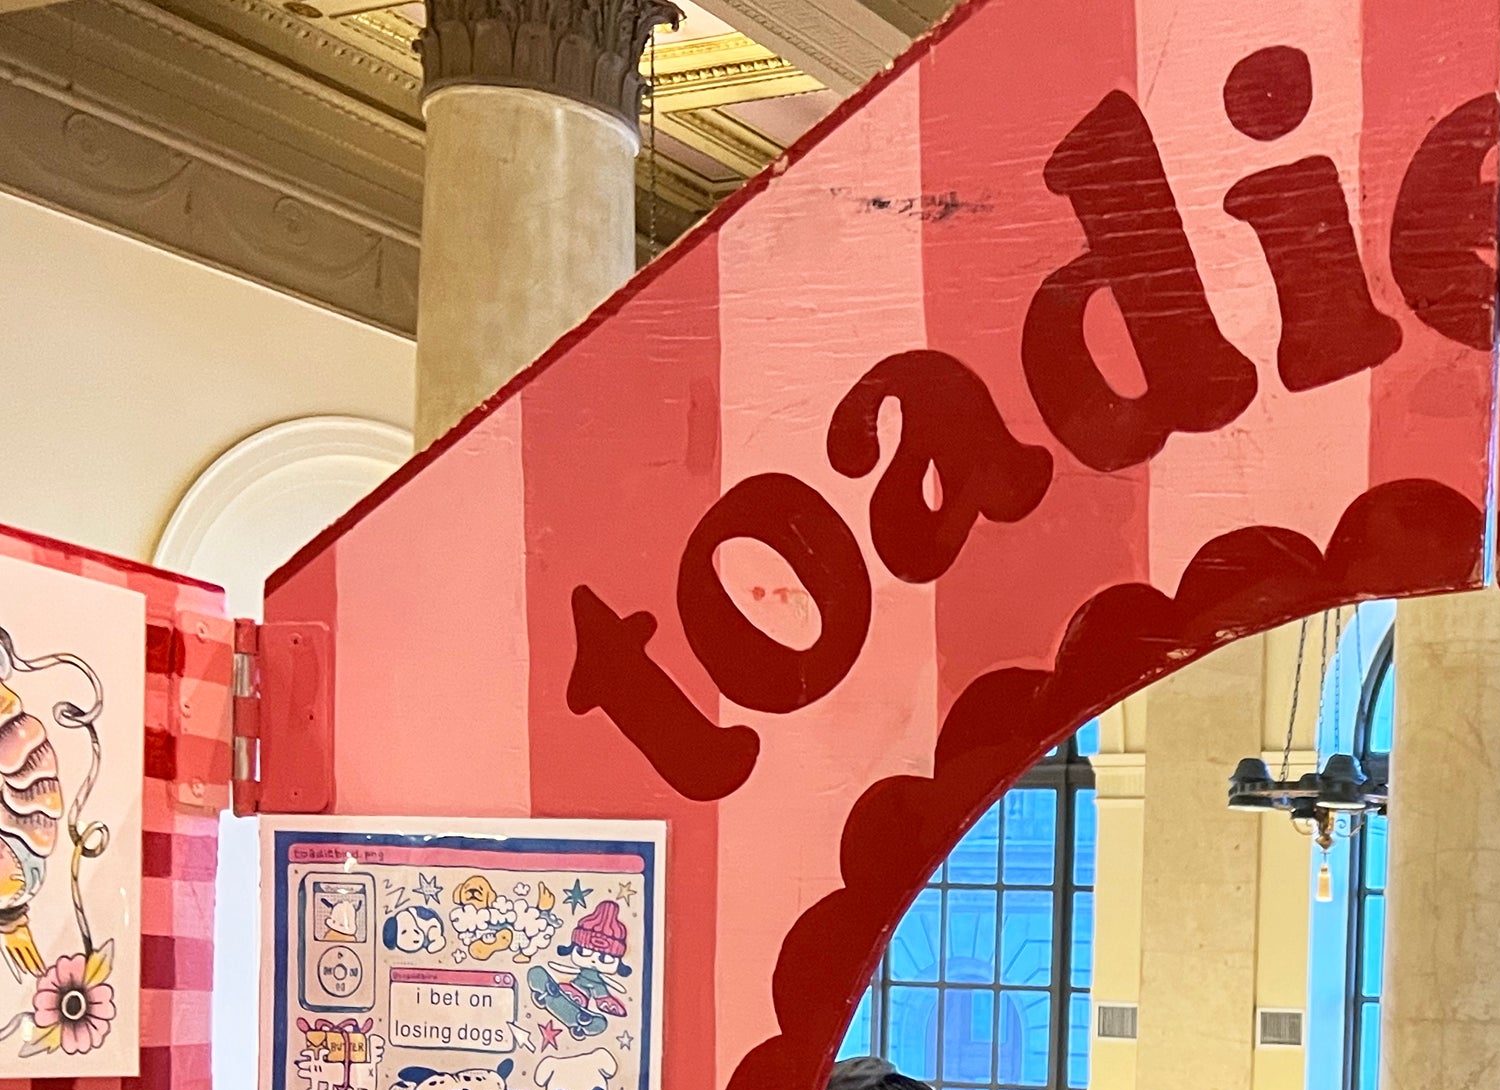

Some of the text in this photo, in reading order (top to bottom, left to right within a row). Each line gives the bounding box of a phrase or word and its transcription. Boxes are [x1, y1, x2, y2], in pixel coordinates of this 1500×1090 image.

[416, 988, 492, 1007] i bet on
[396, 1020, 503, 1046] losing dogs
